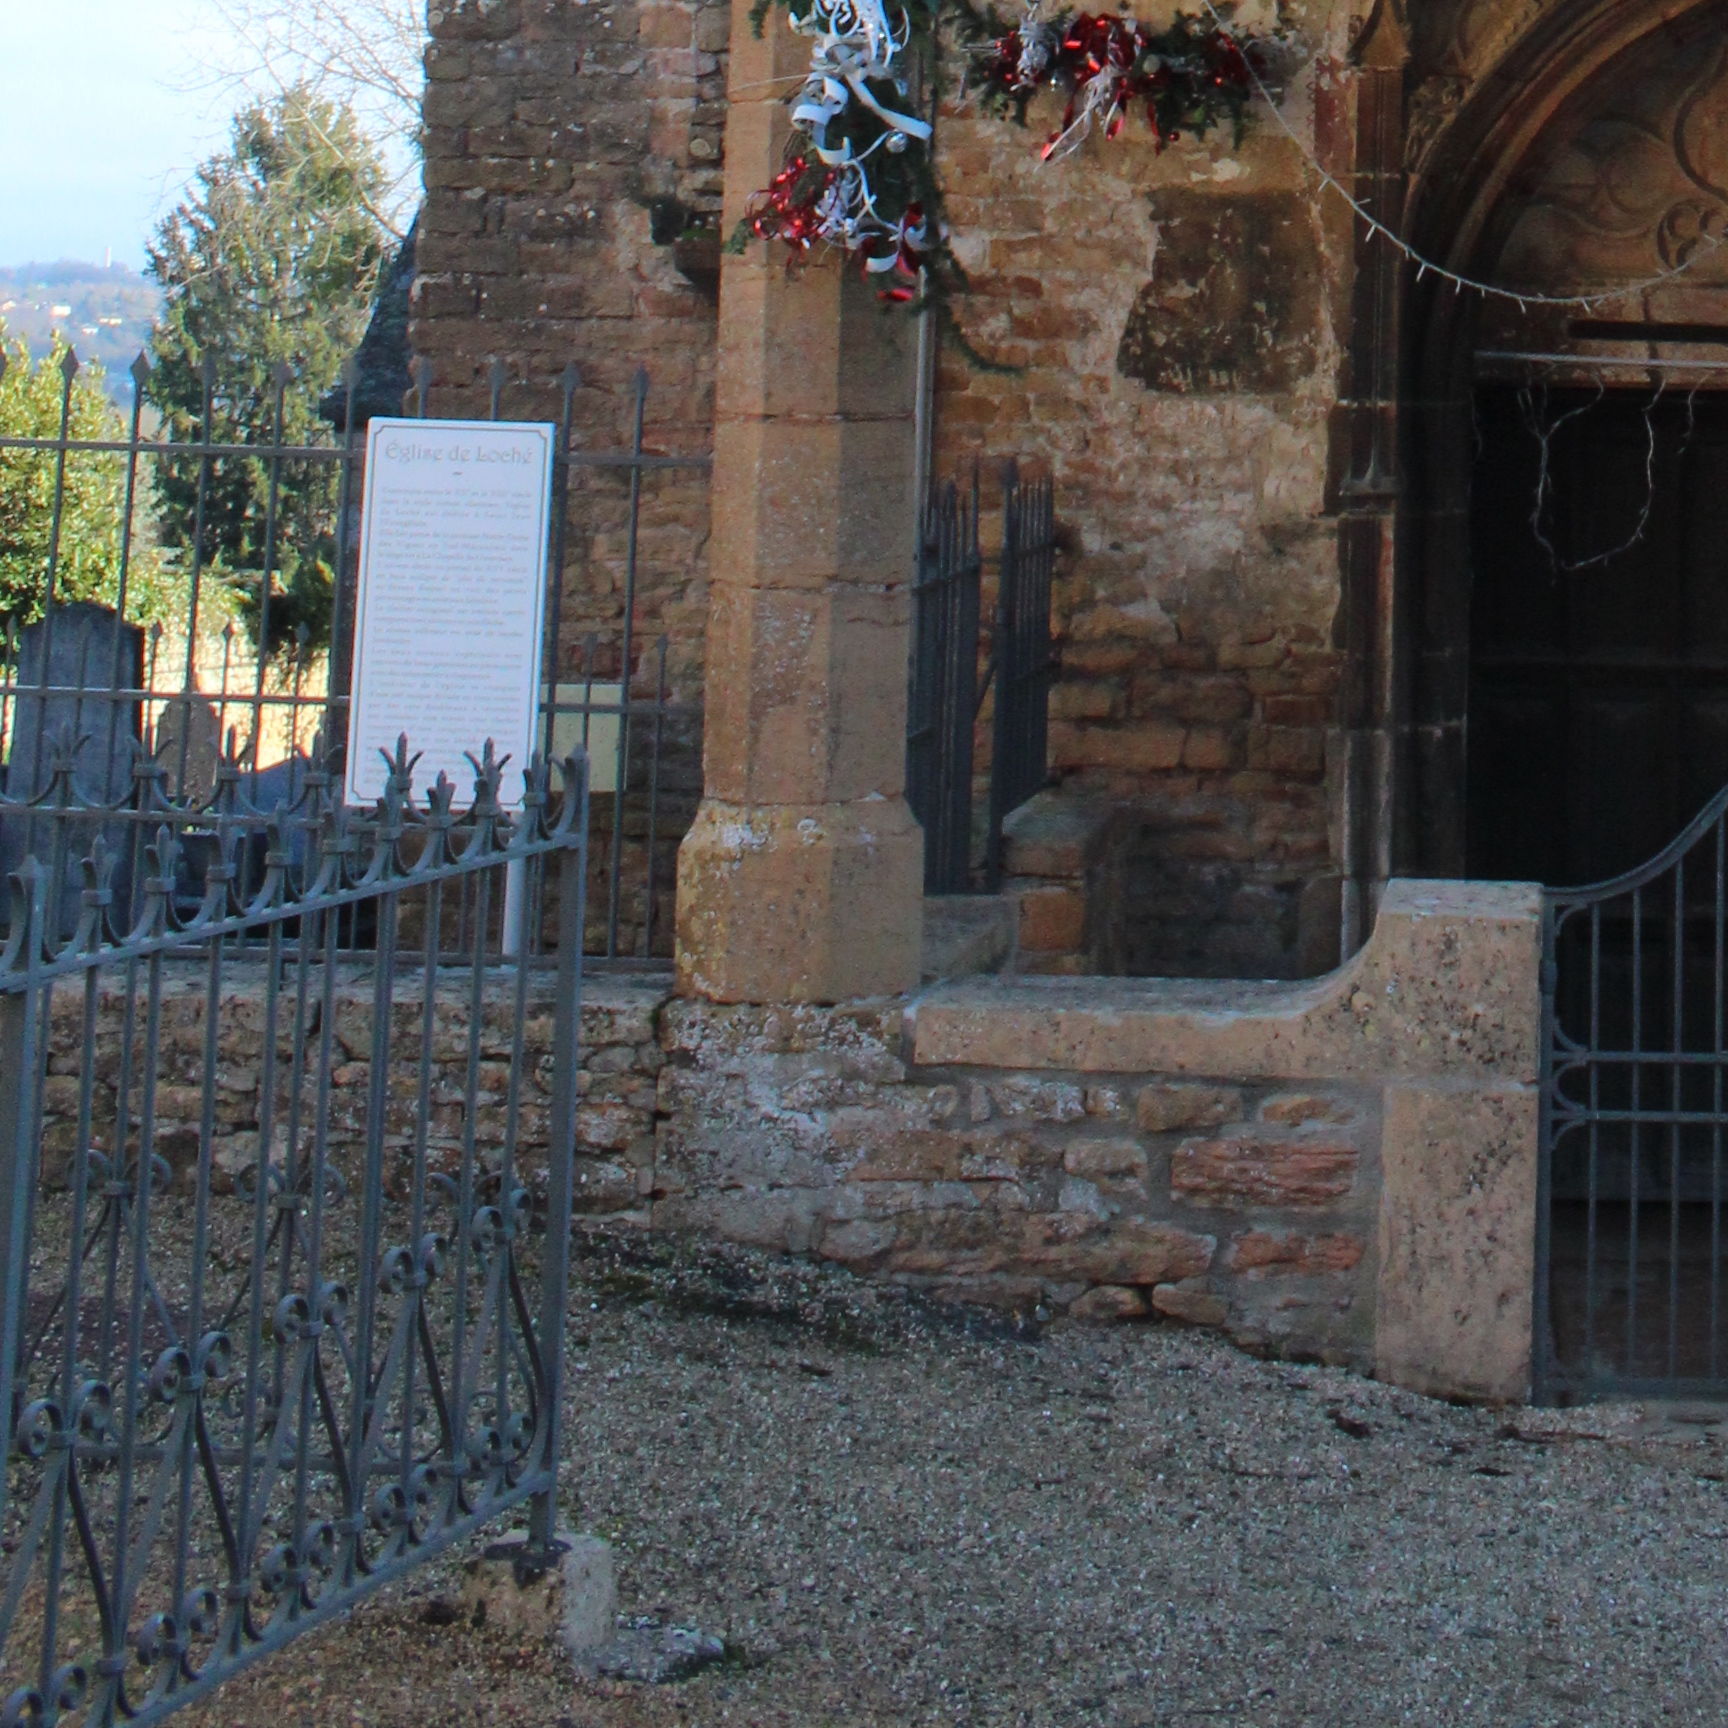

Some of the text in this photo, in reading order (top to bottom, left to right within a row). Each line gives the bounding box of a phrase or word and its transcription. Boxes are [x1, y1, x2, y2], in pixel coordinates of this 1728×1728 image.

[385, 439, 533, 465] Église de Loché
